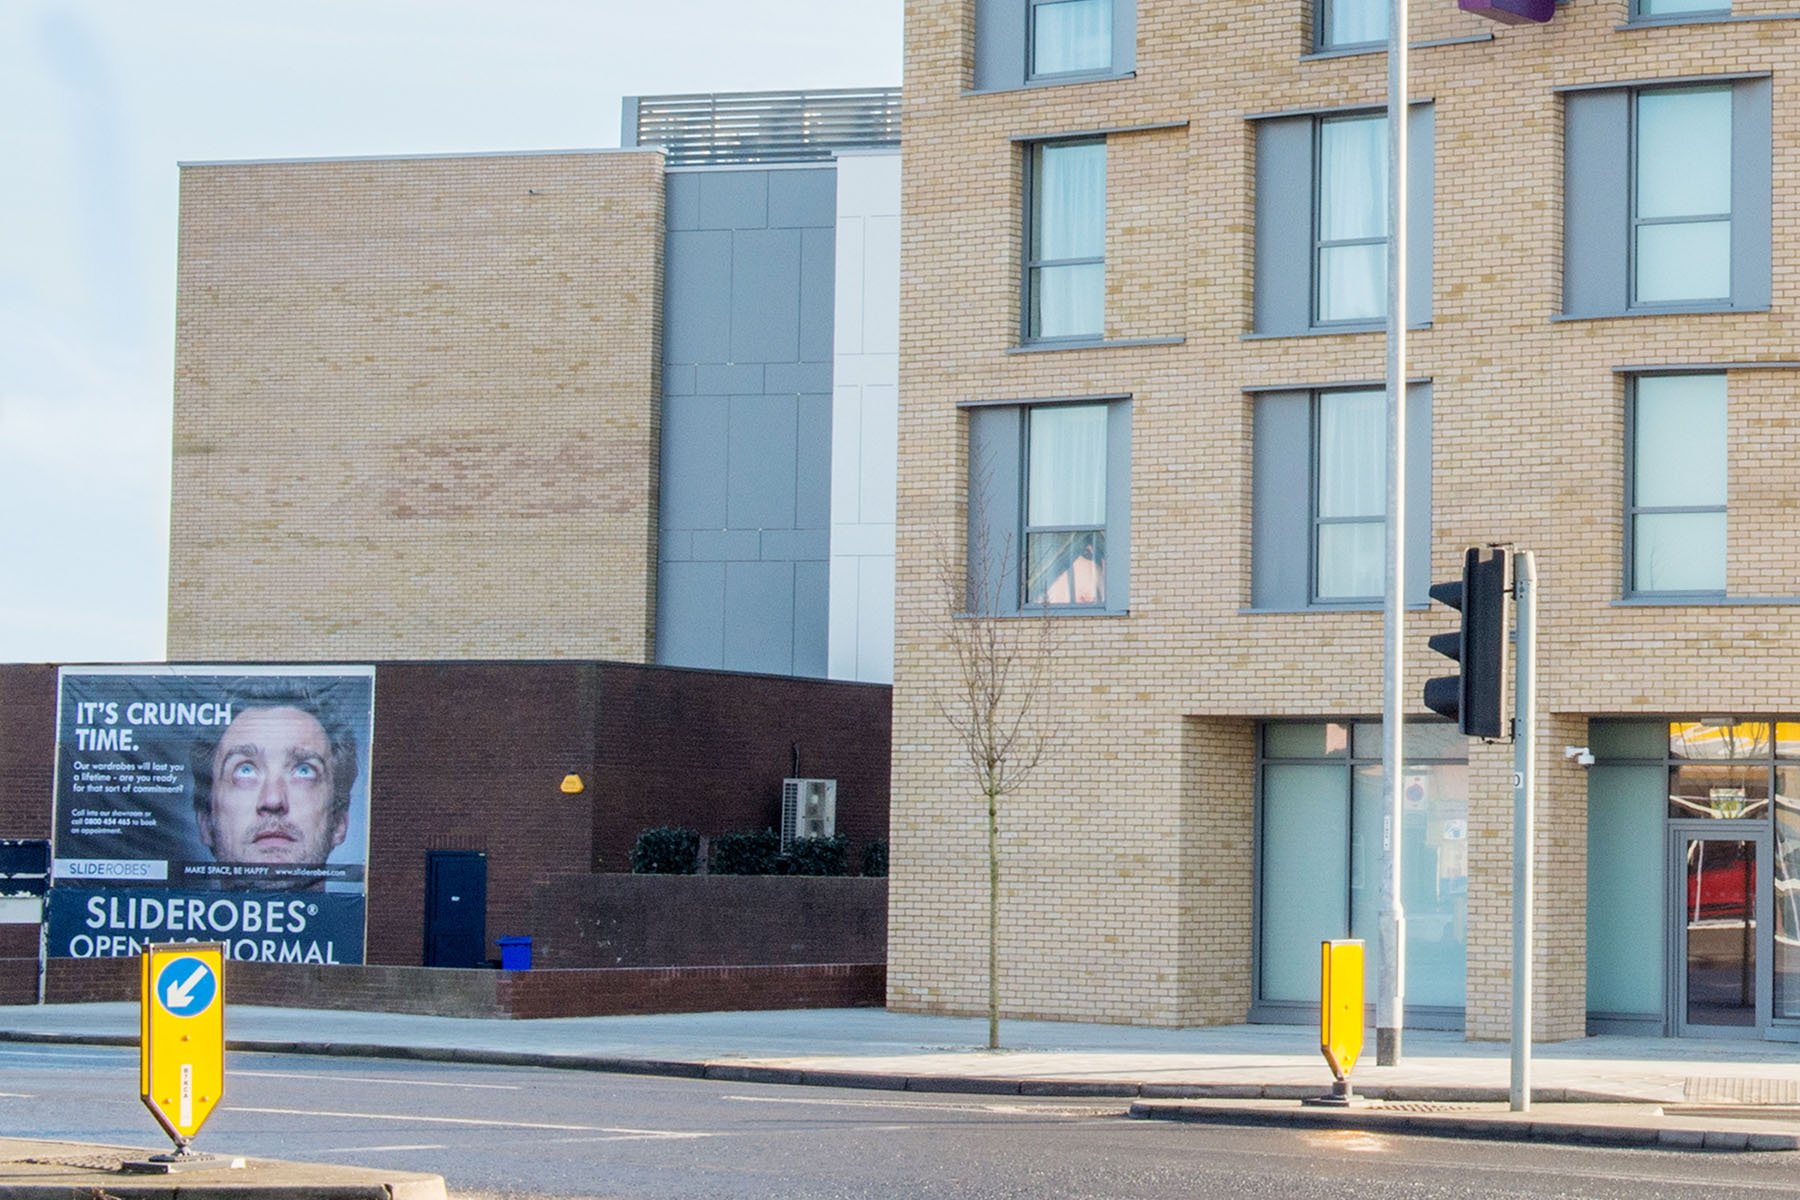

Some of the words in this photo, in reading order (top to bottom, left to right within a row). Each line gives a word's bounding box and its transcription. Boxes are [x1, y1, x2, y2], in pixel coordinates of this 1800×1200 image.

[76, 701, 119, 725] IT'S
[126, 702, 232, 726] CRUNCH
[75, 728, 140, 752] TIME.
[73, 760, 90, 771] Our
[92, 760, 136, 771] wardrobes
[137, 761, 150, 771] will
[152, 762, 168, 772] last
[169, 763, 185, 773] you
[81, 772, 111, 782] lifetime
[119, 774, 134, 782] are
[136, 775, 151, 784] you
[152, 772, 178, 784] ready
[73, 783, 85, 793] for
[86, 783, 103, 793] that
[104, 784, 120, 793] sort
[121, 784, 131, 793] of
[71, 808, 85, 817] Call
[184, 866, 206, 875] MAKE
[207, 866, 232, 876] SPACE,
[233, 866, 243, 875] BE
[244, 867, 270, 876] HAPPY
[275, 868, 346, 877] www.sliderobes.com
[69, 935, 149, 958] OPEN
